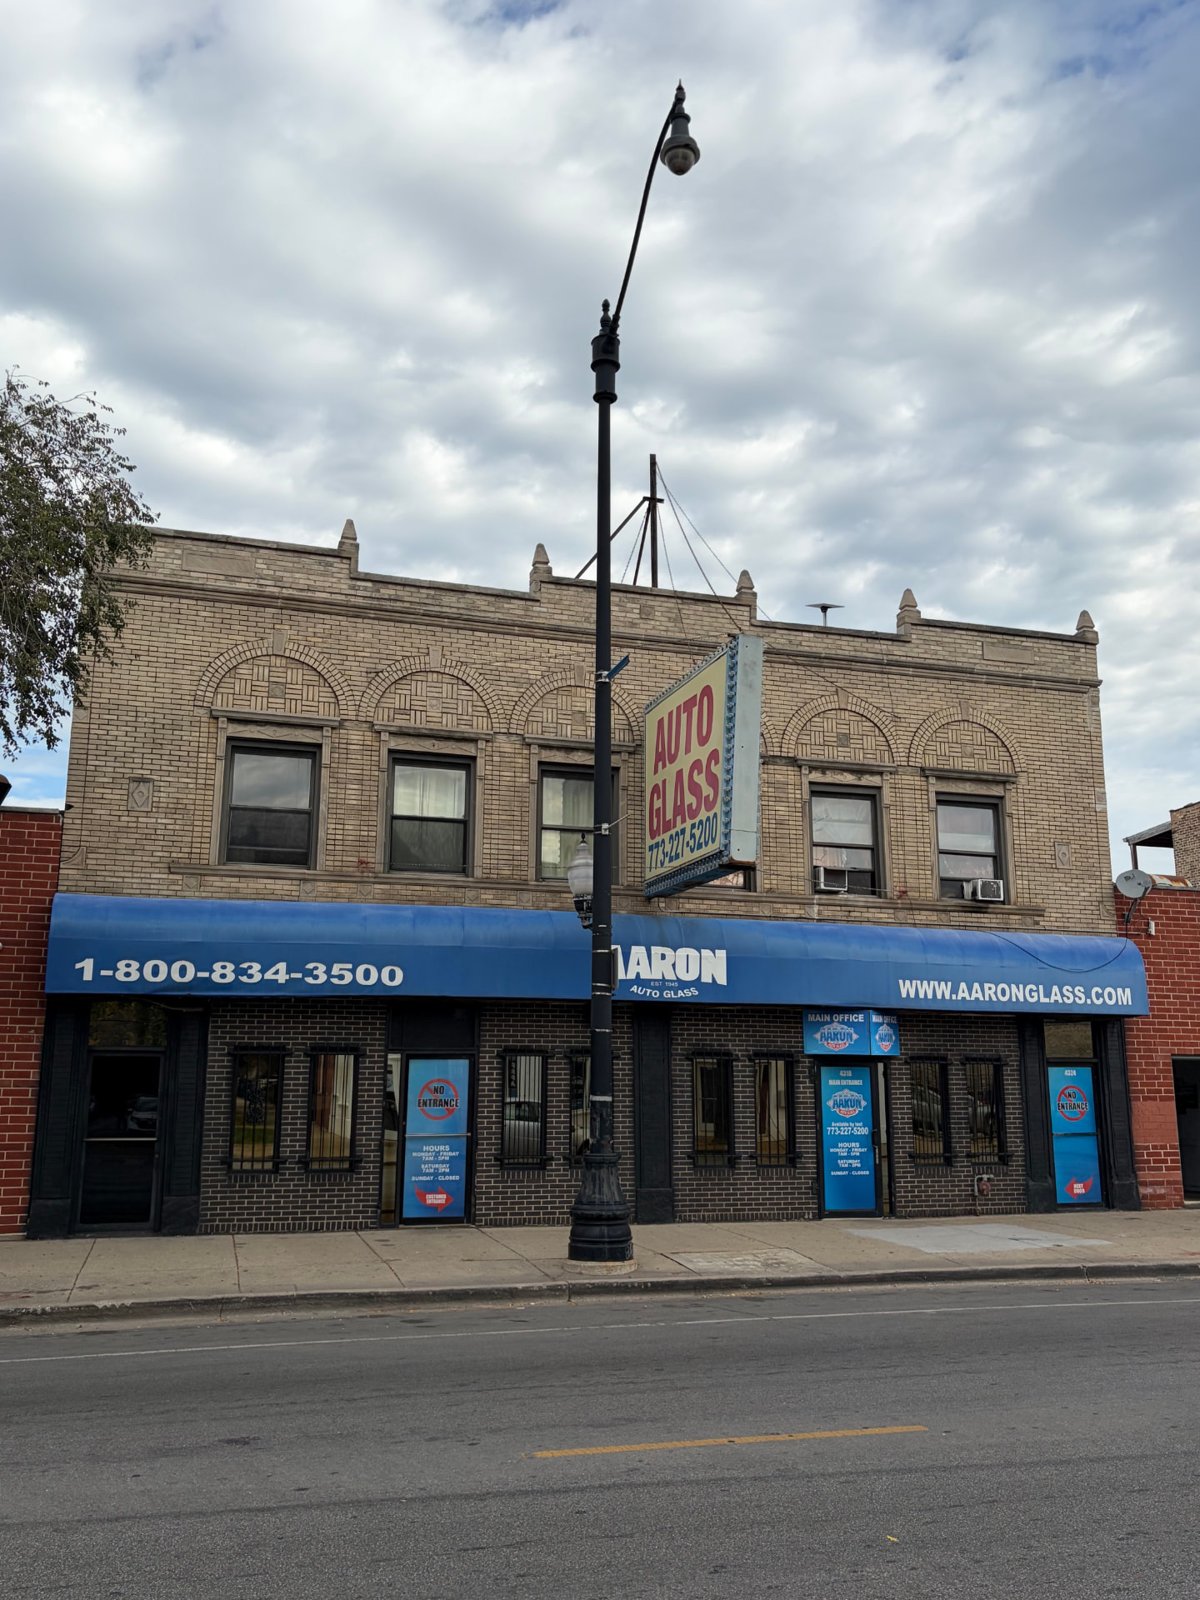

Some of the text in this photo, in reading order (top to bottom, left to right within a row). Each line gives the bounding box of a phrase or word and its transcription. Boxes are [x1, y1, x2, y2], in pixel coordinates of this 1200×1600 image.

[653, 684, 714, 776] AUTO
[648, 748, 720, 841] GLASS
[648, 811, 718, 873] 773-227-5200
[74, 958, 404, 987] 1-800-834-3500
[629, 985, 699, 999] AUTO GLASS
[898, 979, 1132, 1006] WWW.AARONGLASS.COM
[808, 1013, 865, 1022] MAIN OFFICE
[433, 1085, 445, 1095] NO
[1067, 1091, 1077, 1099] NO
[417, 1098, 460, 1108] ENTRANCE
[1057, 1102, 1089, 1111] ENTRANCE
[826, 1127, 869, 1136] 773-227-5200
